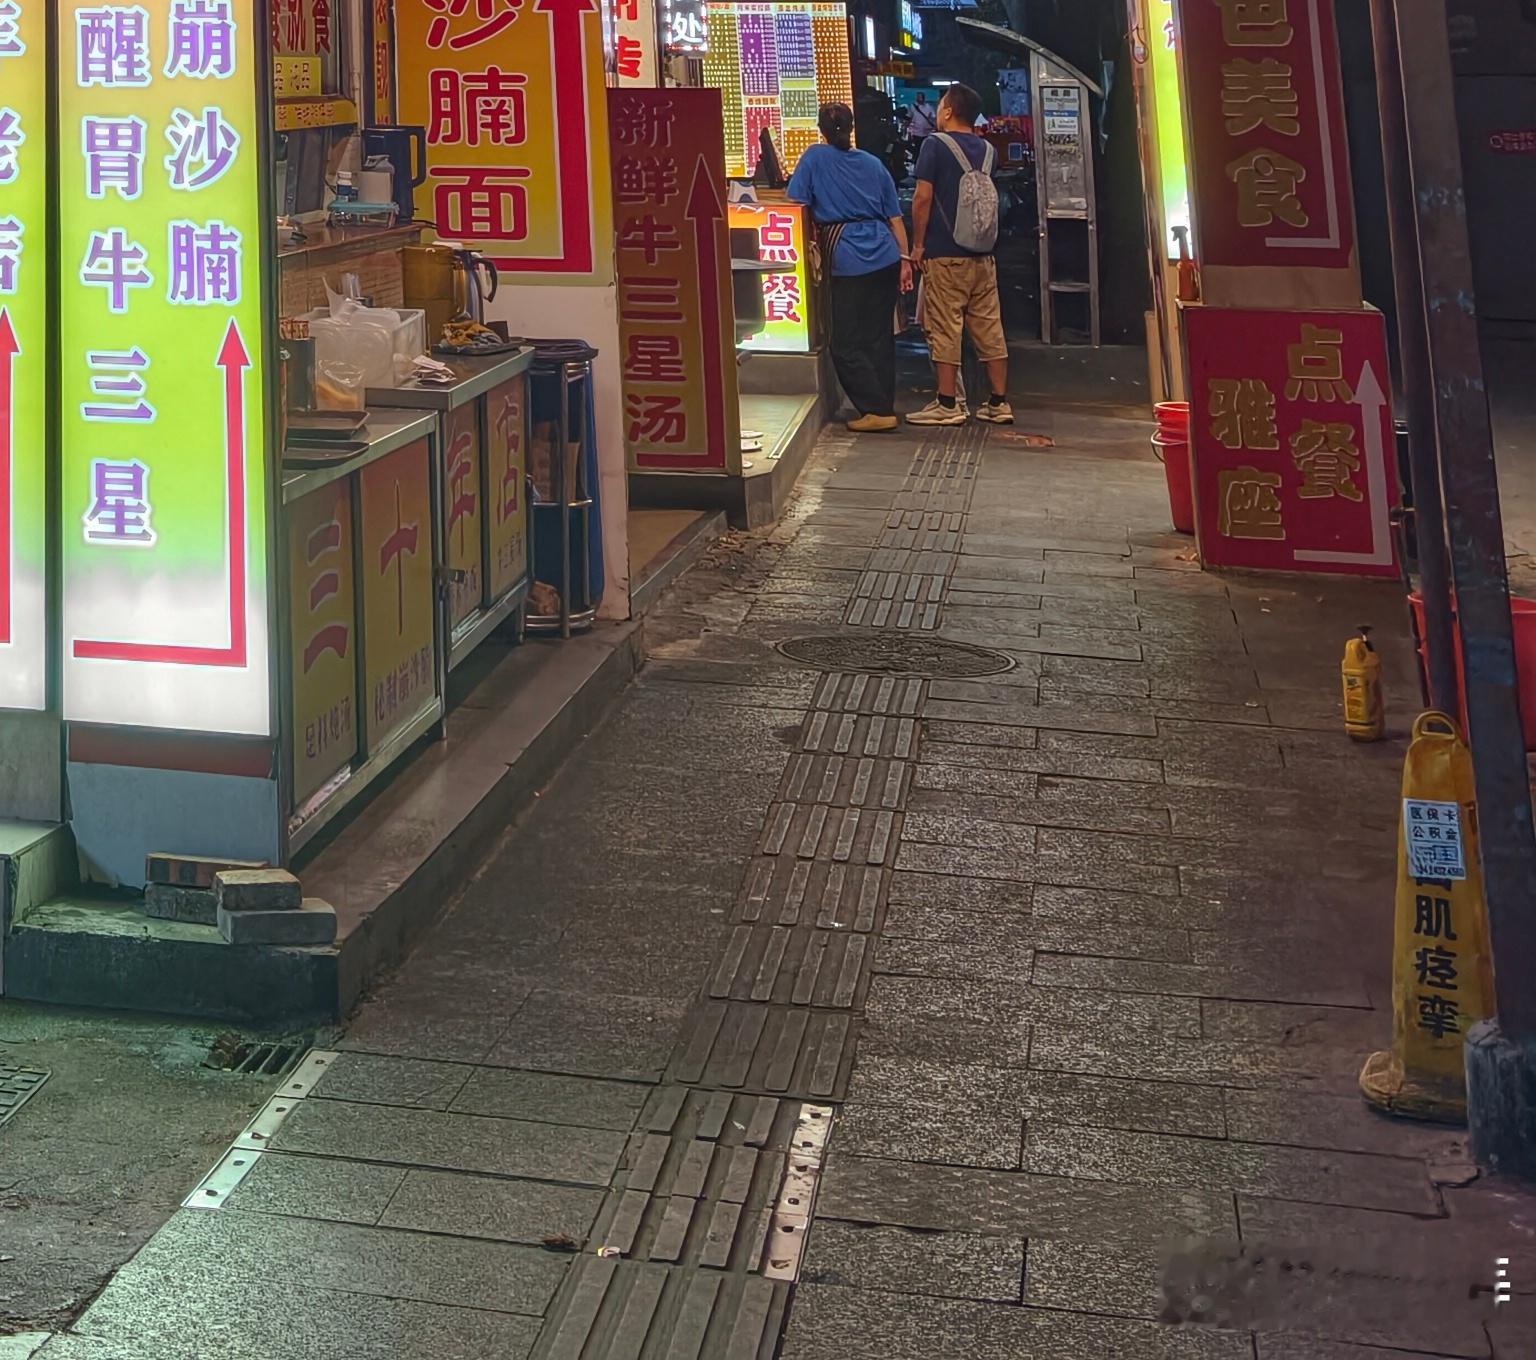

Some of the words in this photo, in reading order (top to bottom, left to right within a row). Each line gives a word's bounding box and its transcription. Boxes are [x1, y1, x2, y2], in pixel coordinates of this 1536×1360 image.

[74, 3, 155, 549] 醒胃牛三星
[616, 98, 687, 445] 新鲜牛三星汤
[759, 212, 801, 322] 点餐
[1208, 377, 1286, 541] 雅座
[1284, 323, 1363, 503] 点餐
[1414, 878, 1461, 1040] 肌痉挛
